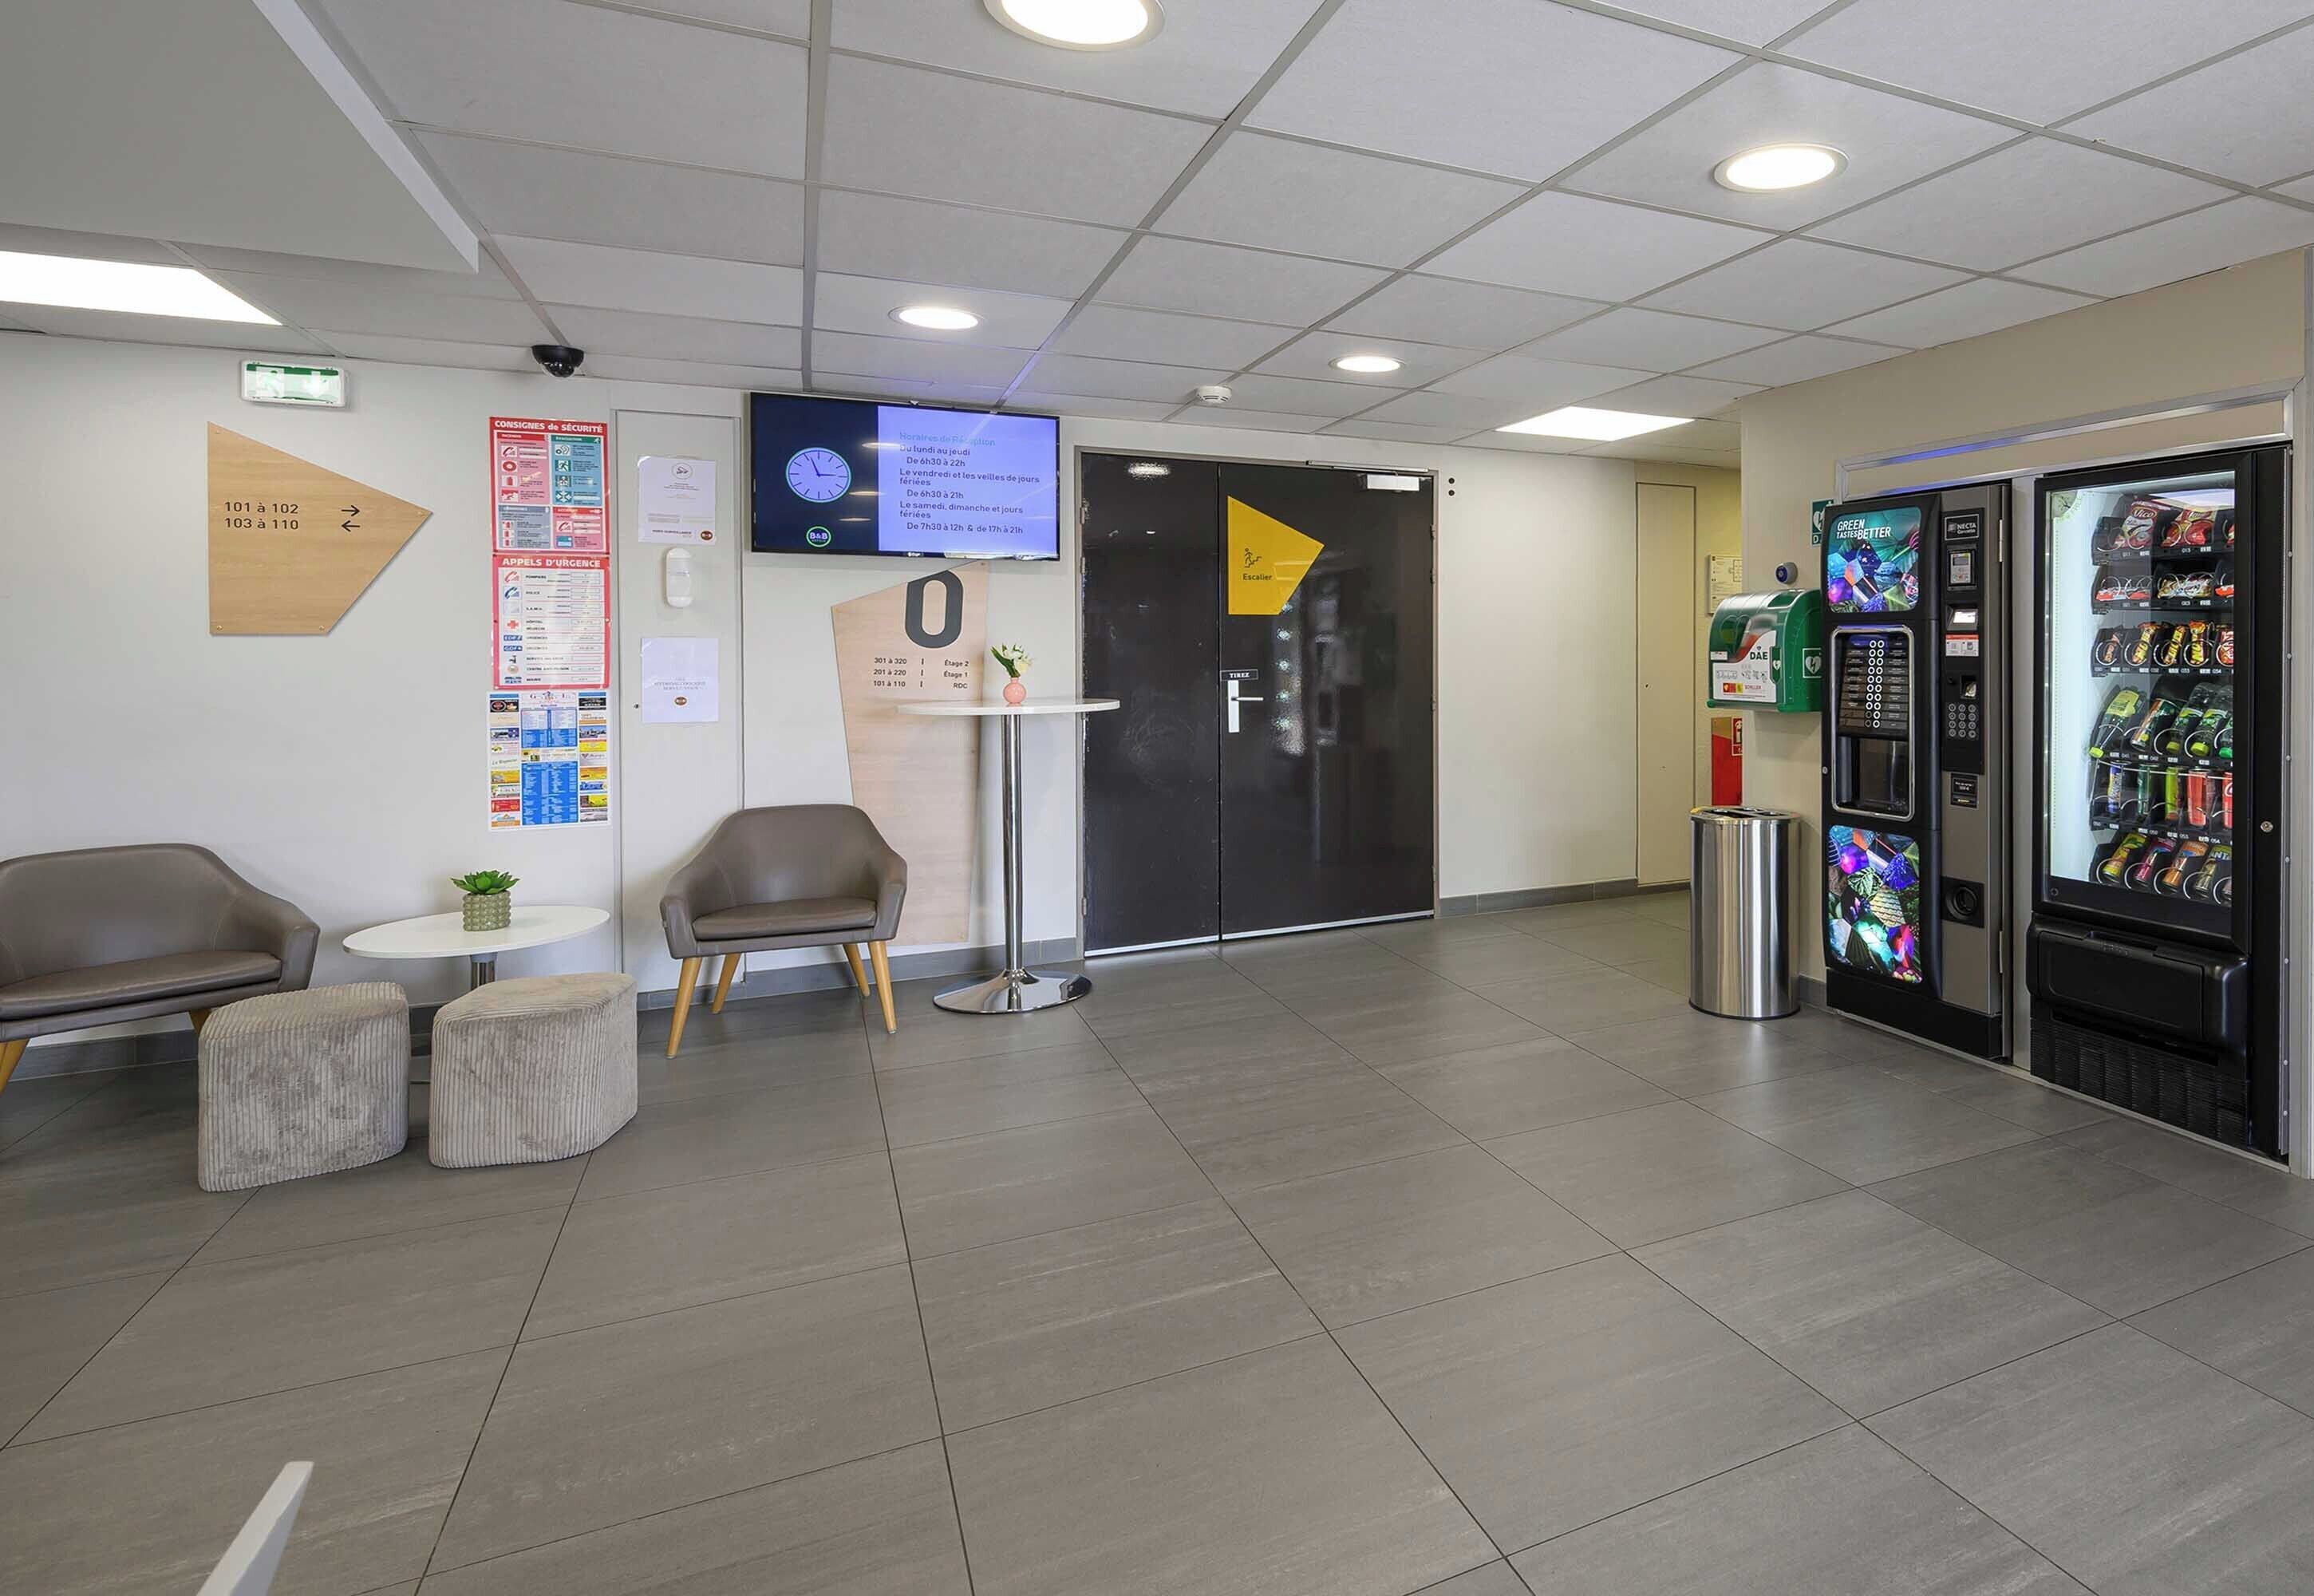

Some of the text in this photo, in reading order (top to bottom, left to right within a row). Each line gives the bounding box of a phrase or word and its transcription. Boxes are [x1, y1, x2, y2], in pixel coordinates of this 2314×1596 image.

[495, 421, 545, 430] CONSIGNES
[561, 423, 603, 433] SÉCURITÉ
[950, 448, 970, 456] jeudi
[900, 476, 931, 486] fériées
[977, 472, 1005, 481] veilles
[224, 502, 298, 514] 101 à 102
[948, 504, 990, 512] dimanche
[1001, 505, 1024, 514] jours
[900, 509, 931, 519] fériées
[2133, 509, 2154, 518] Vico
[224, 518, 298, 530] 103 à 110
[1837, 519, 1866, 531] GREEN
[1836, 530, 1858, 539] TASTES
[1857, 527, 1891, 540] BETTER
[546, 559, 601, 567] D'URGENCE
[905, 570, 964, 649] 0
[1750, 651, 1769, 661] DAE
[944, 659, 963, 668] Étage
[943, 670, 962, 679] Étage
